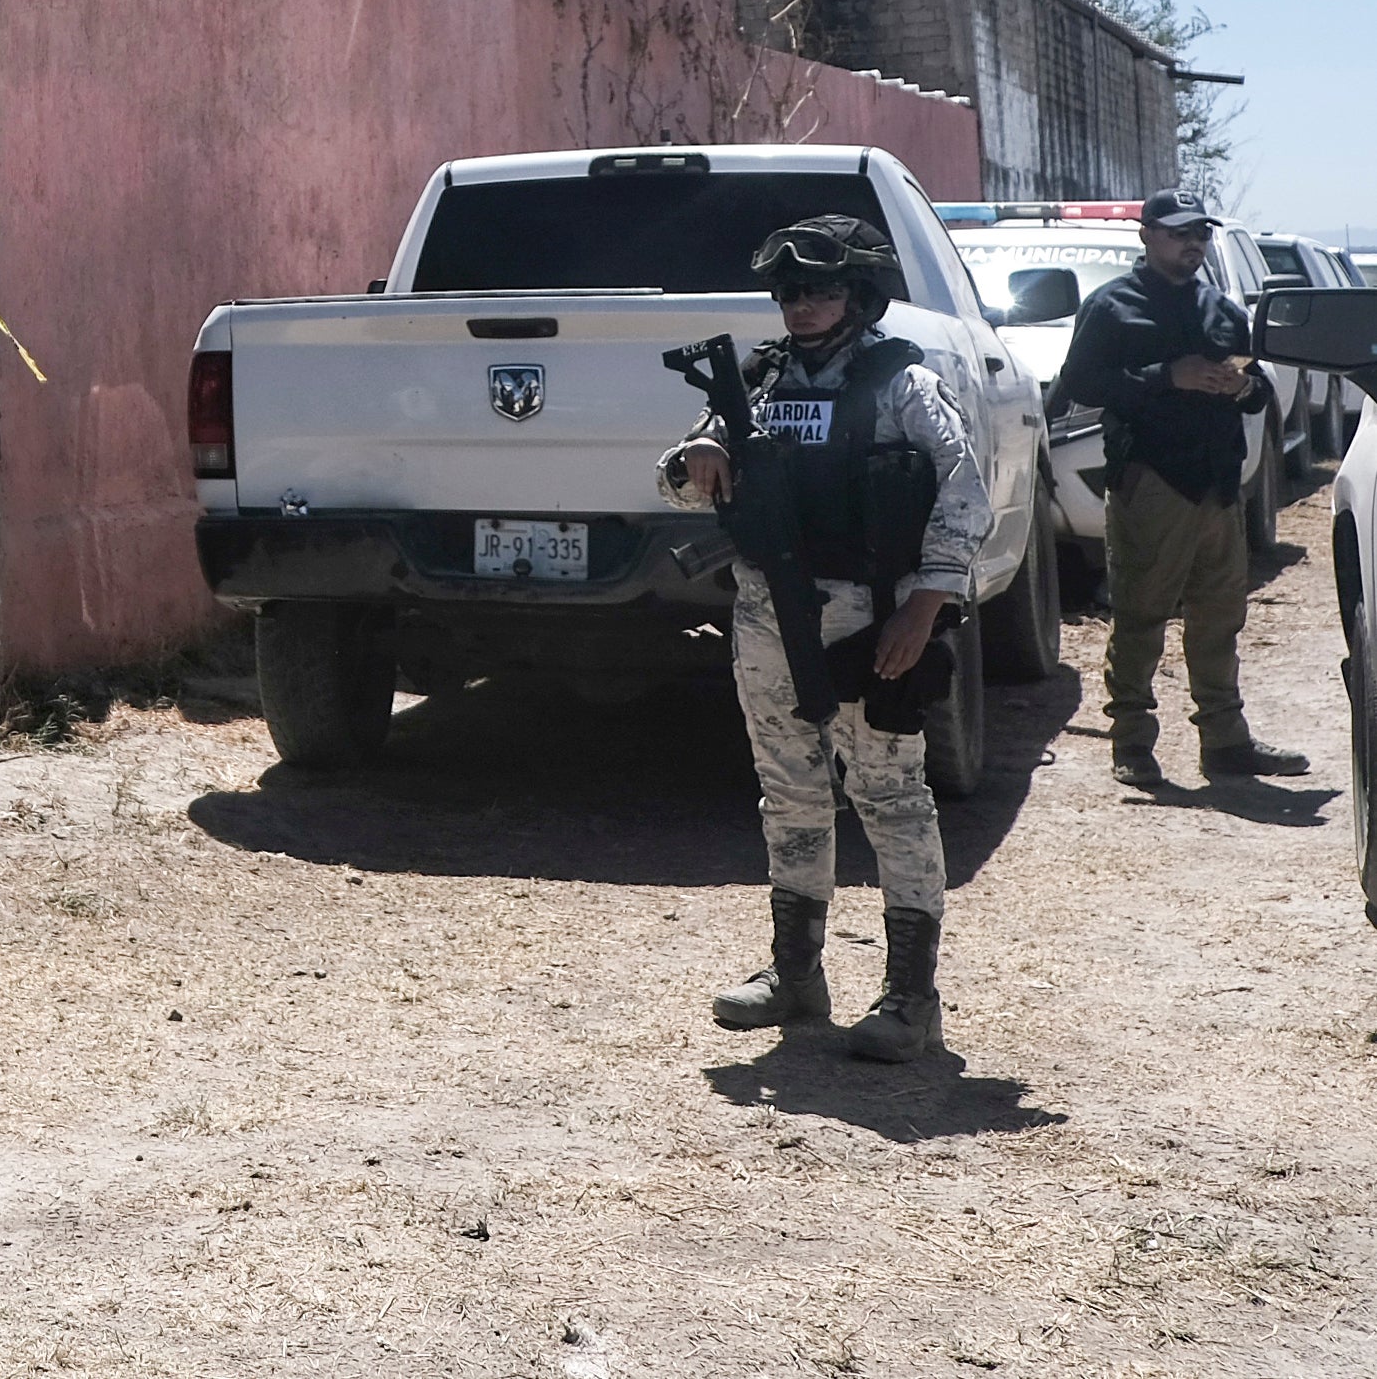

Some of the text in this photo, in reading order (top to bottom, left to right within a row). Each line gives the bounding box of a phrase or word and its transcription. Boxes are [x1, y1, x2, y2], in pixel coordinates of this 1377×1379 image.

[994, 245, 1133, 266] MUNICIPAL
[763, 404, 822, 421] UARDIA
[478, 534, 583, 561] JR-91-335
